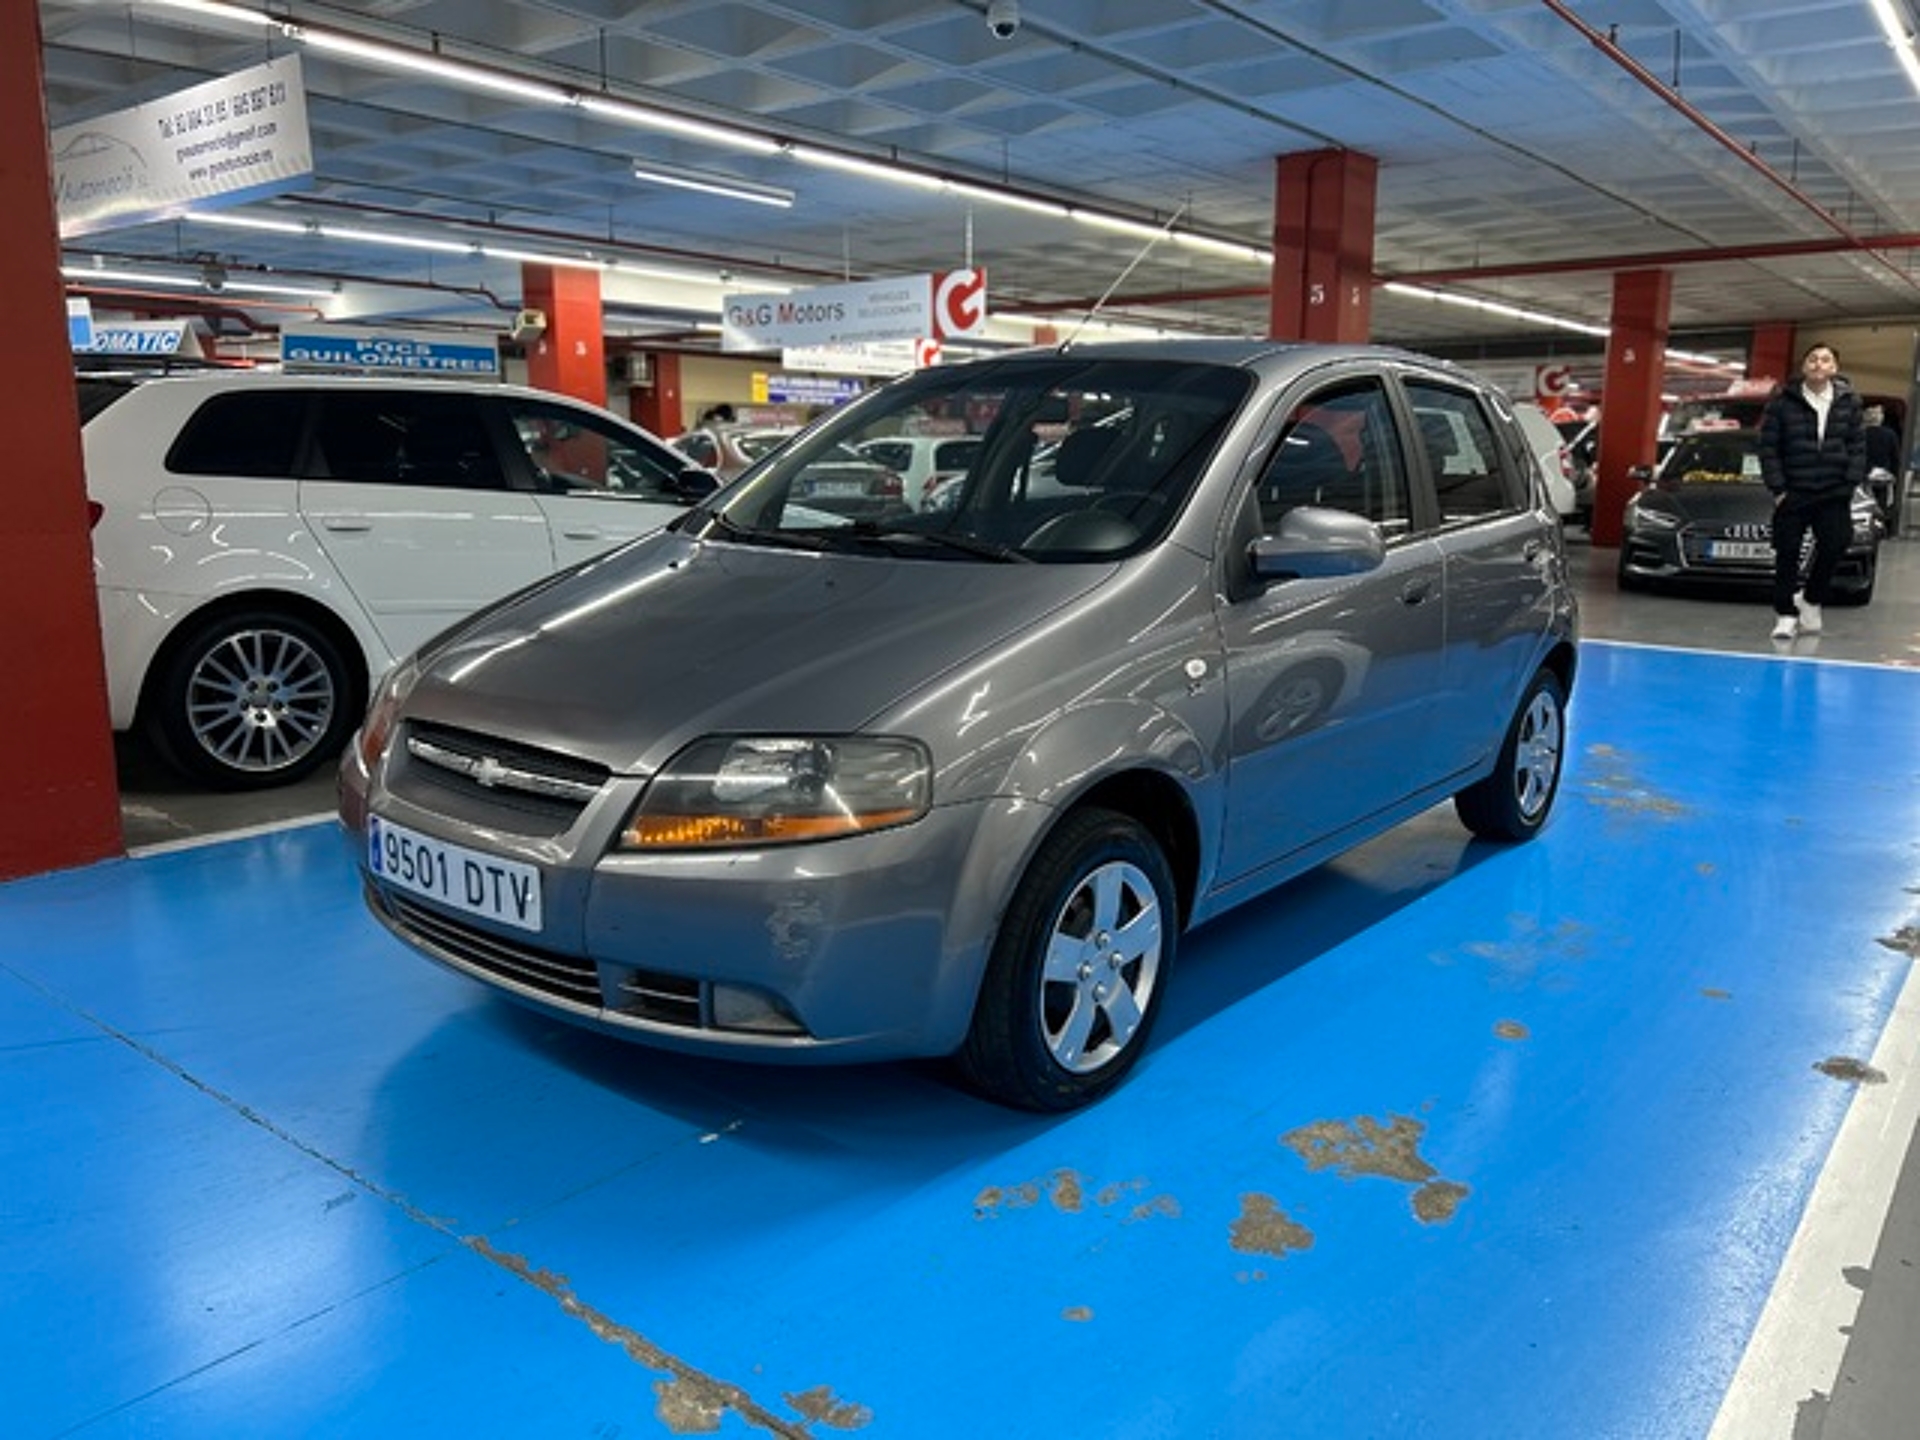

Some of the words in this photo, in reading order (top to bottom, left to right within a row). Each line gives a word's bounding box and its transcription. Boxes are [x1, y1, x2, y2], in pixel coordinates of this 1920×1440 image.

[1310, 283, 1324, 304] 5
[728, 303, 772, 327] G&G
[776, 301, 845, 324] Motors
[74, 330, 181, 352] OMATIC
[356, 340, 432, 356] POCS
[289, 347, 494, 372] QUILOMETRES
[386, 832, 448, 897] 9501
[464, 859, 530, 920] DTV
